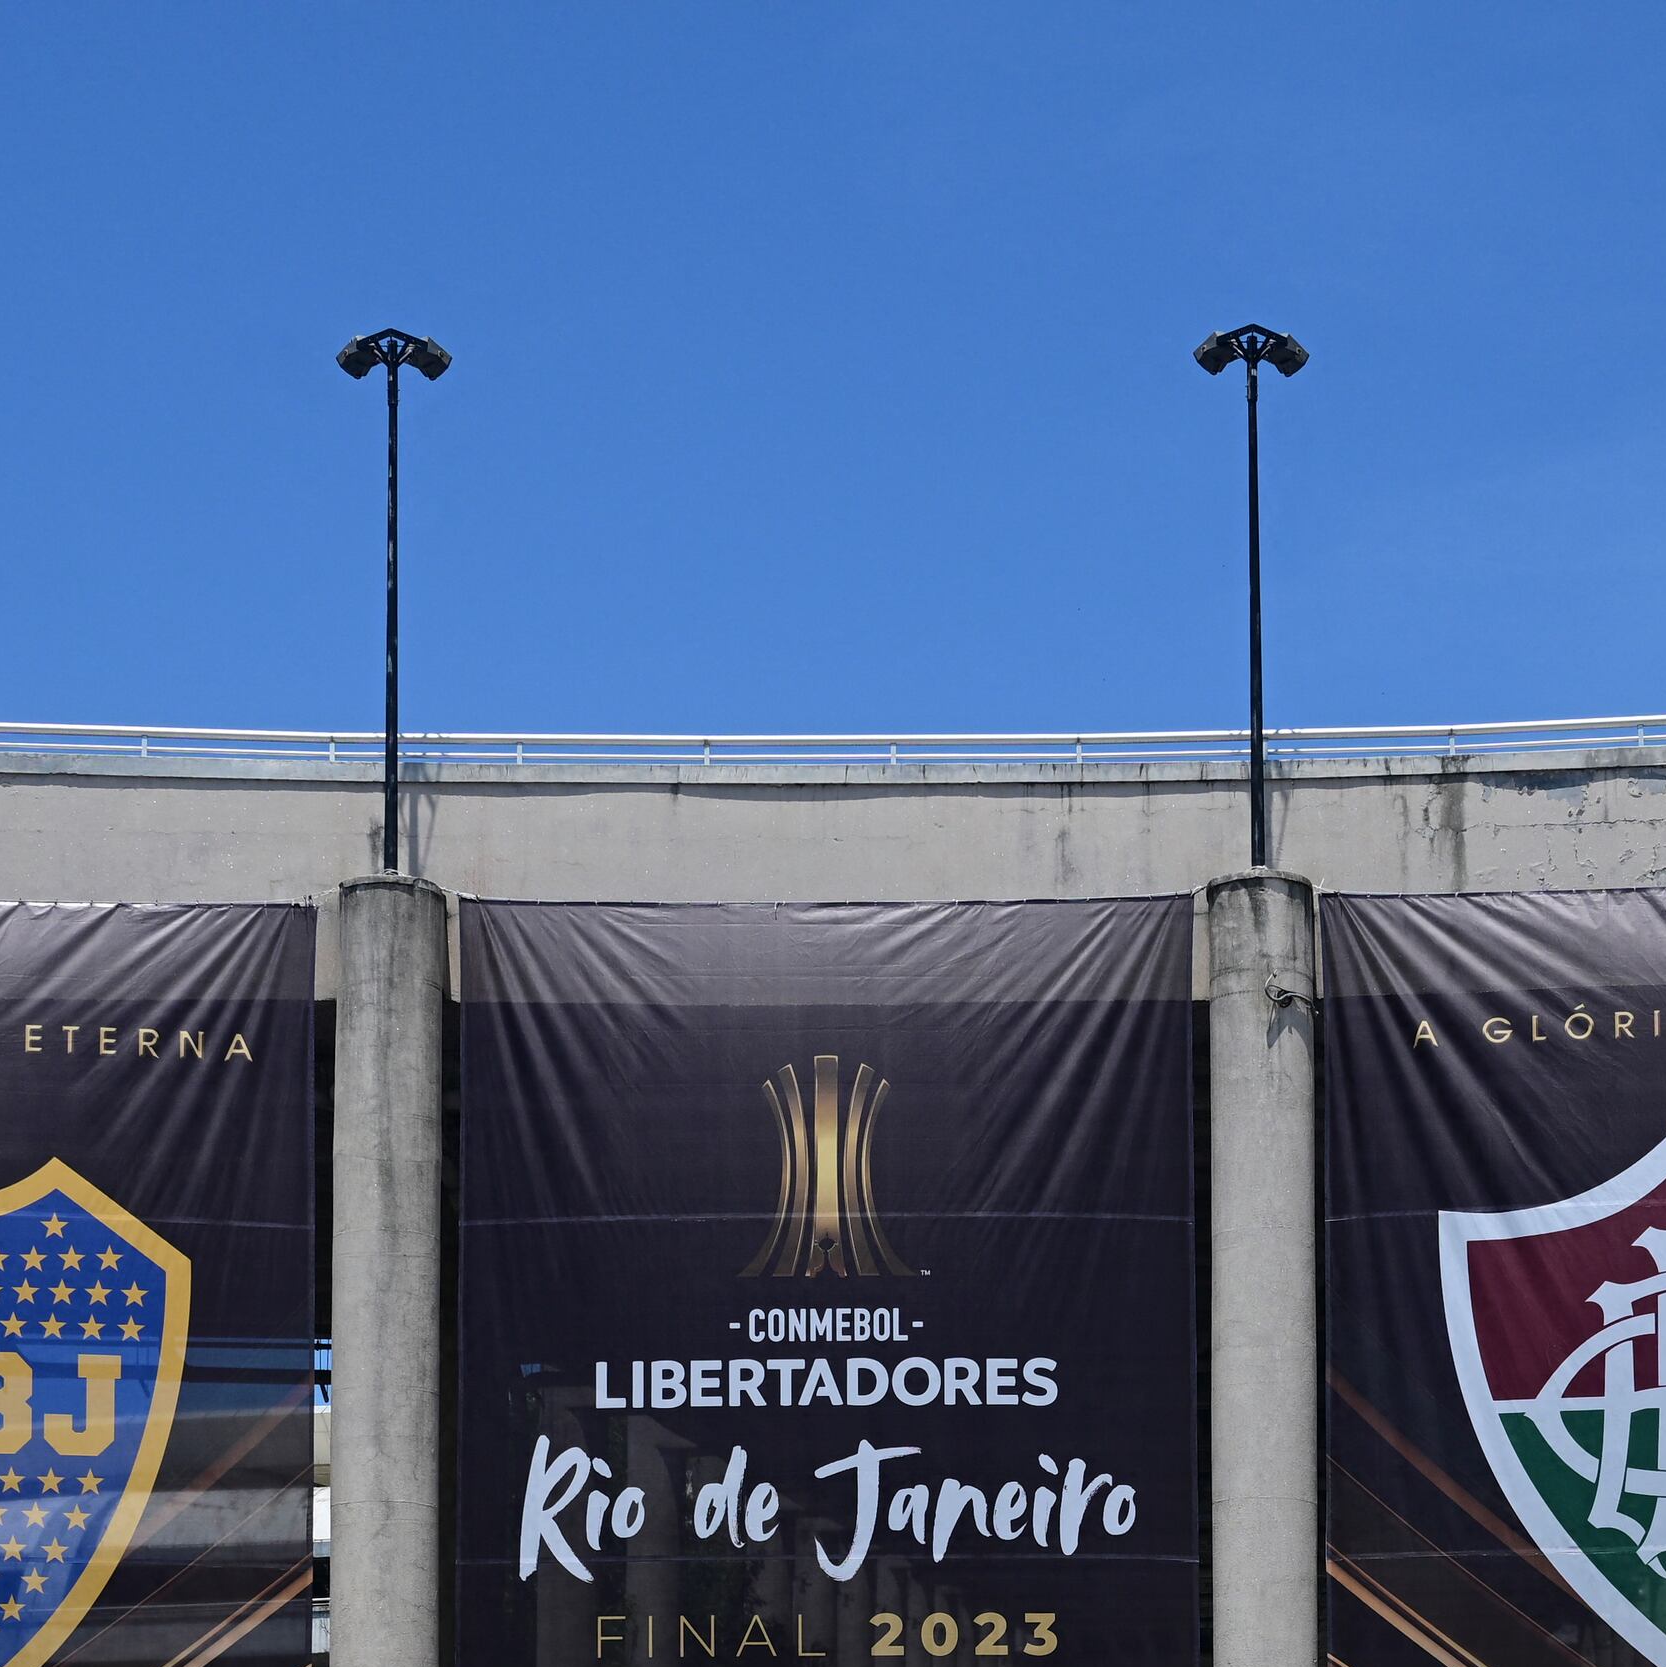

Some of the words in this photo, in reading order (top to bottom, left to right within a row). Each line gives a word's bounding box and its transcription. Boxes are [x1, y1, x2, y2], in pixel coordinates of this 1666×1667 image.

[23, 1023, 254, 1063] ETERNA
[1413, 1018, 1440, 1049] A
[594, 1356, 1059, 1410] LIBERTADORES
[517, 1434, 647, 1583] Rio
[692, 1445, 780, 1548] de
[813, 1438, 1137, 1582] Janeiro
[595, 1614, 827, 1659] FINAL
[868, 1611, 1060, 1657] 2023
